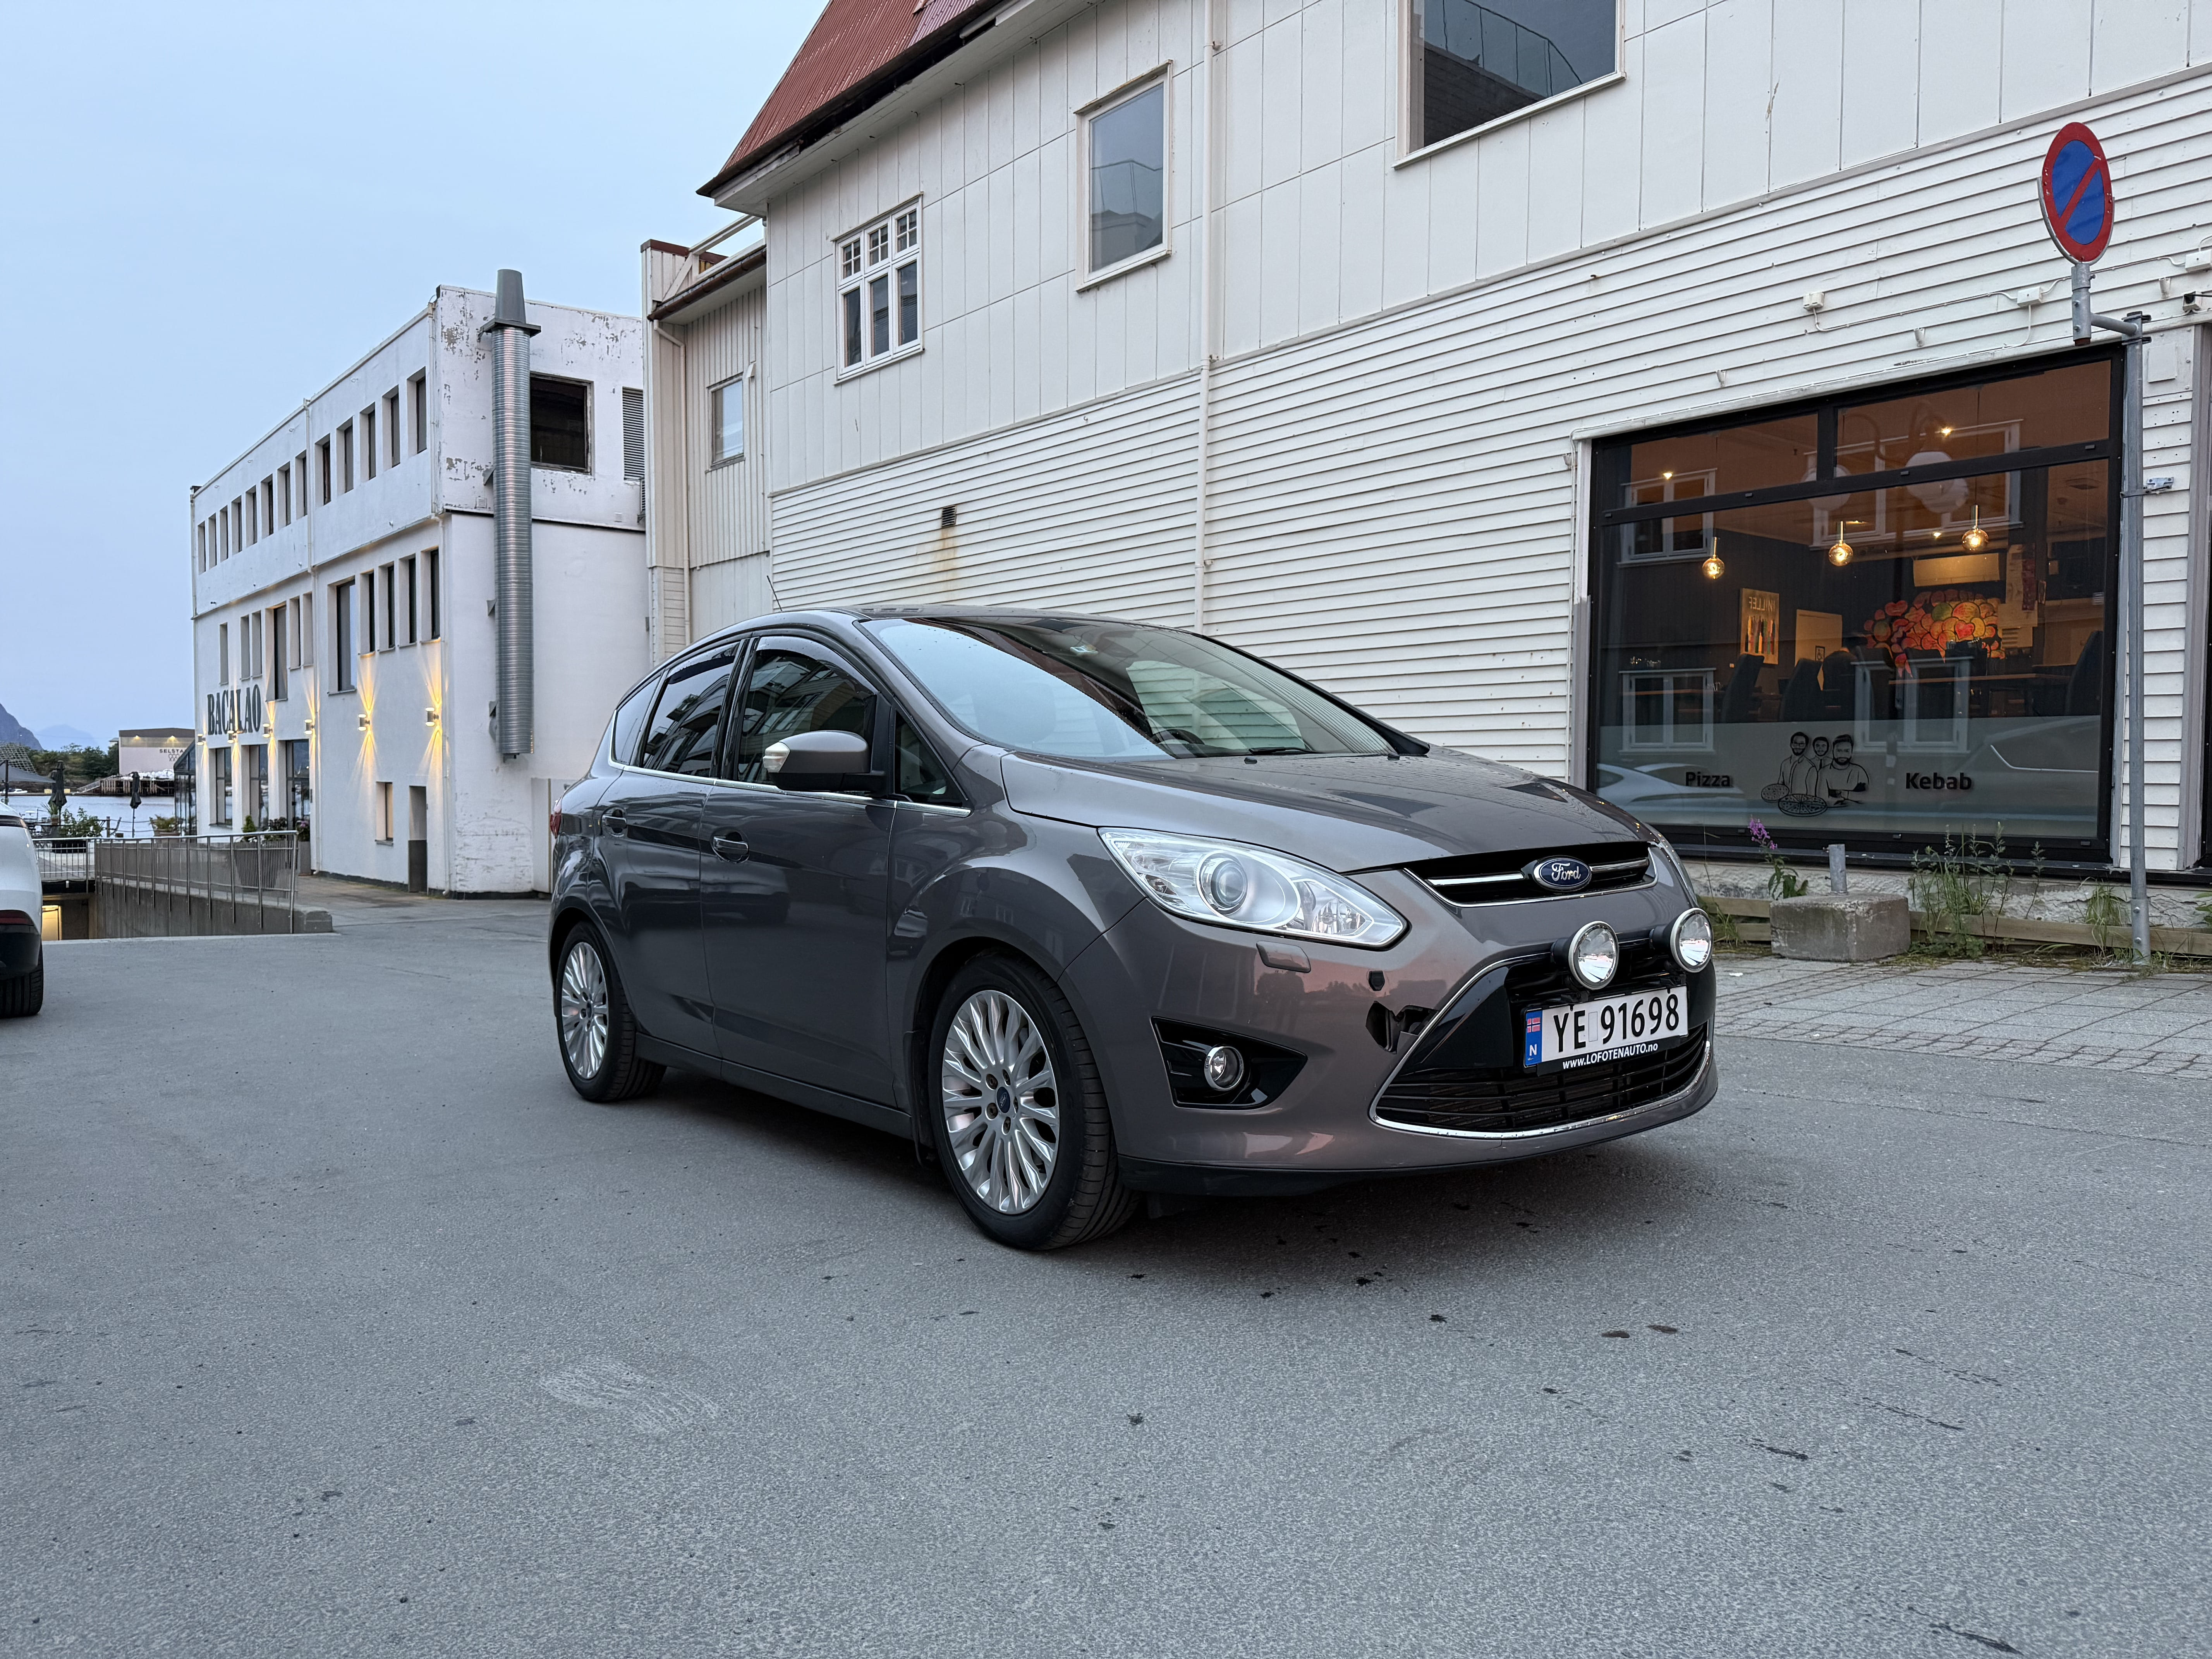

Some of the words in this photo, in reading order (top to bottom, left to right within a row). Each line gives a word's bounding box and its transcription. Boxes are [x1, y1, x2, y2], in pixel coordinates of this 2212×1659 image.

[207, 684, 261, 735] BACALAO
[1686, 771, 1730, 787] Pizza
[1906, 773, 1972, 790] Kebab
[1551, 863, 1581, 881] Ford
[1553, 1010, 1586, 1053] YE
[1601, 994, 1679, 1044] 91698
[1529, 1044, 1537, 1056] N
[1563, 1043, 1658, 1069] www.LOFOTENAUTO.no
